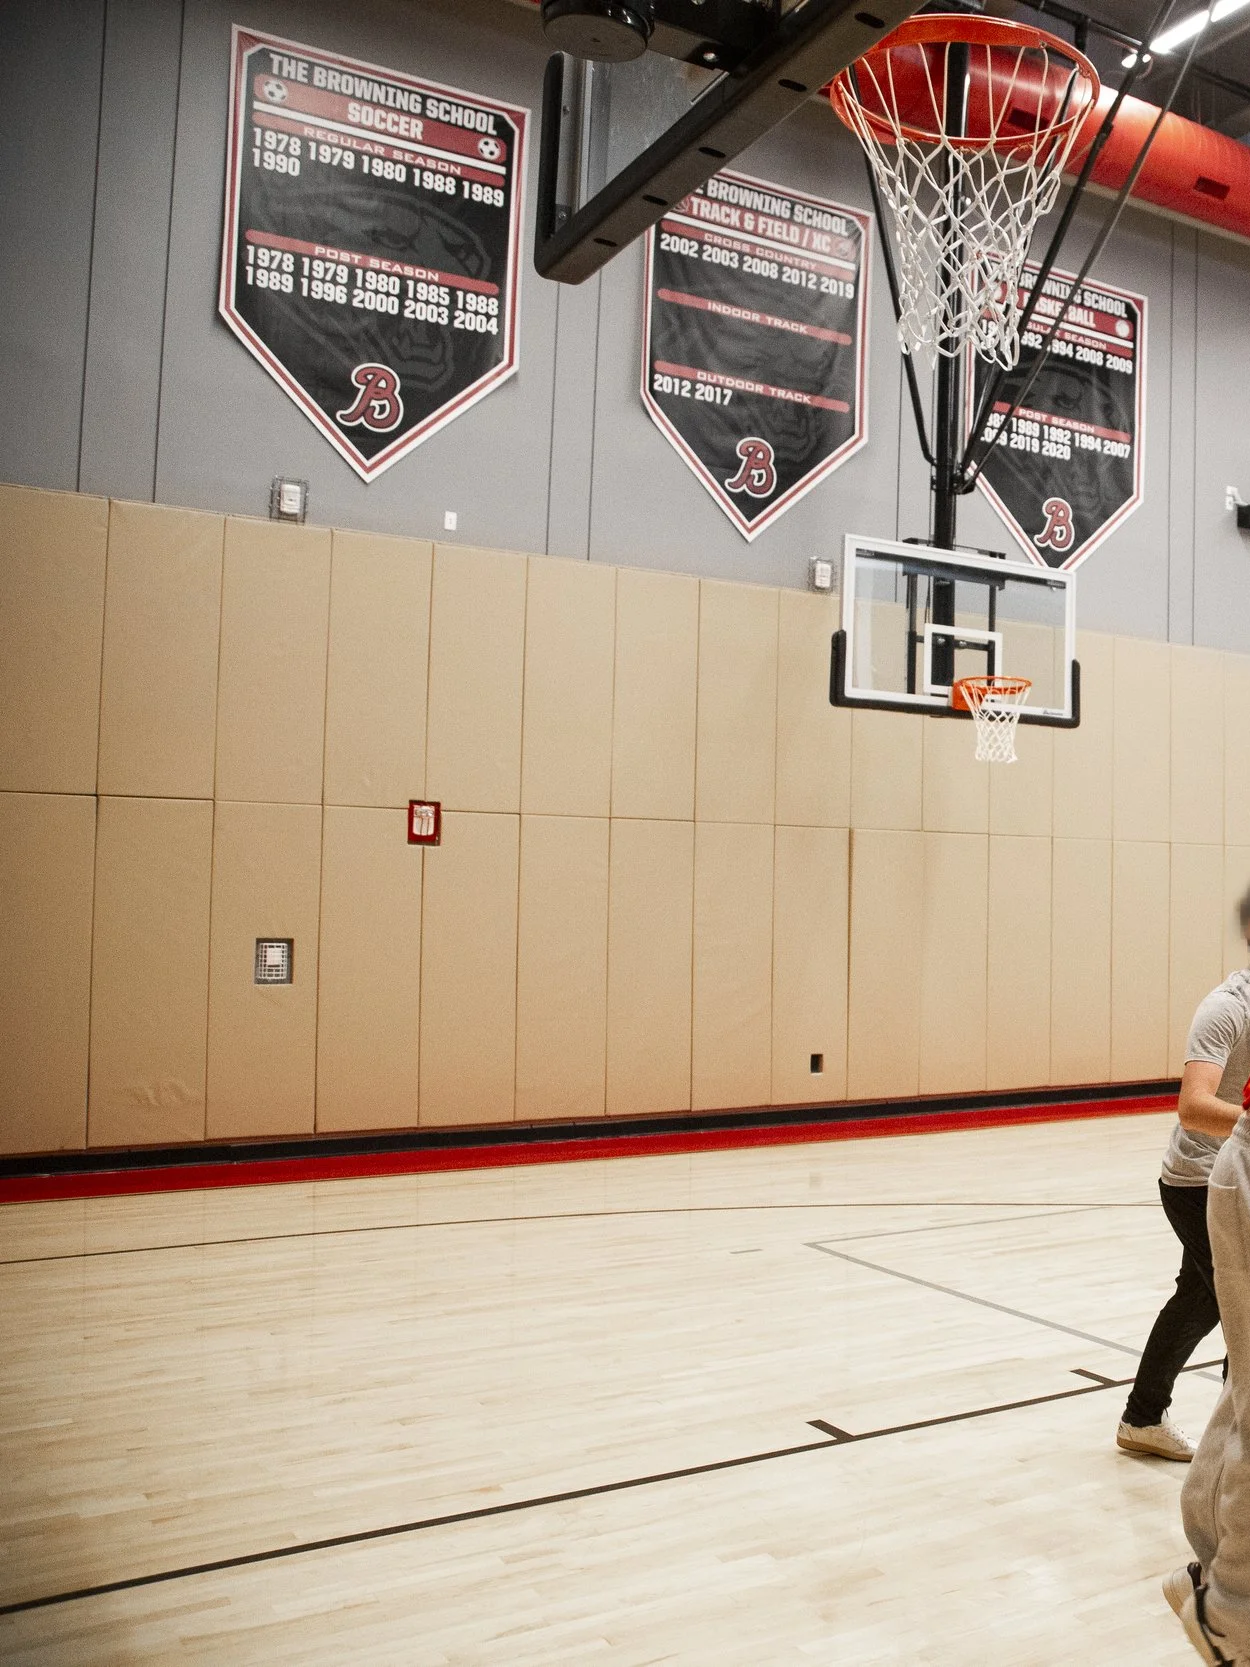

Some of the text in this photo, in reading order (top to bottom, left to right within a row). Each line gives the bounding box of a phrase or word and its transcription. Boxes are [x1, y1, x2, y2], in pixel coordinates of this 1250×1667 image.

[269, 52, 497, 135] THE BROWNING SCHOOL
[347, 103, 423, 140] SOCCER
[252, 147, 300, 177] 1990
[253, 127, 505, 207] 1978 1979 1980 1988 1989
[304, 126, 462, 175] REGULAR SEASON
[690, 197, 740, 227] TRACK
[757, 217, 798, 244] FIELD
[707, 179, 849, 237] BROWNING SCHOOL
[315, 246, 439, 281] POST SEASON
[660, 234, 854, 300] 2002 2003 2008 2012 2019
[704, 232, 817, 270] CROSS COUNTRY
[245, 265, 498, 335] 1989 1996 2000 2003 2004
[246, 245, 498, 316] 1978 1979 1980 1985 1988
[707, 302, 808, 335] INDOOR TRACK
[1083, 290, 1128, 318] SCHOOL
[1046, 338, 1074, 358] 994
[1075, 345, 1104, 366] 2008
[1105, 354, 1133, 375] 2009
[1064, 331, 1107, 351] SEASON
[336, 362, 404, 432] B
[653, 374, 733, 406] 2012 2017
[696, 371, 812, 405] OUTDOOR TRACK
[1011, 417, 1040, 438] 1989
[1043, 425, 1071, 446] 1992
[1074, 432, 1102, 452] 1994
[1103, 439, 1131, 459] 2007
[1018, 407, 1095, 433] POST SEASON
[725, 436, 777, 498] B
[1009, 433, 1040, 454] 2019
[1042, 440, 1071, 461] 2020
[1034, 497, 1075, 552] B
